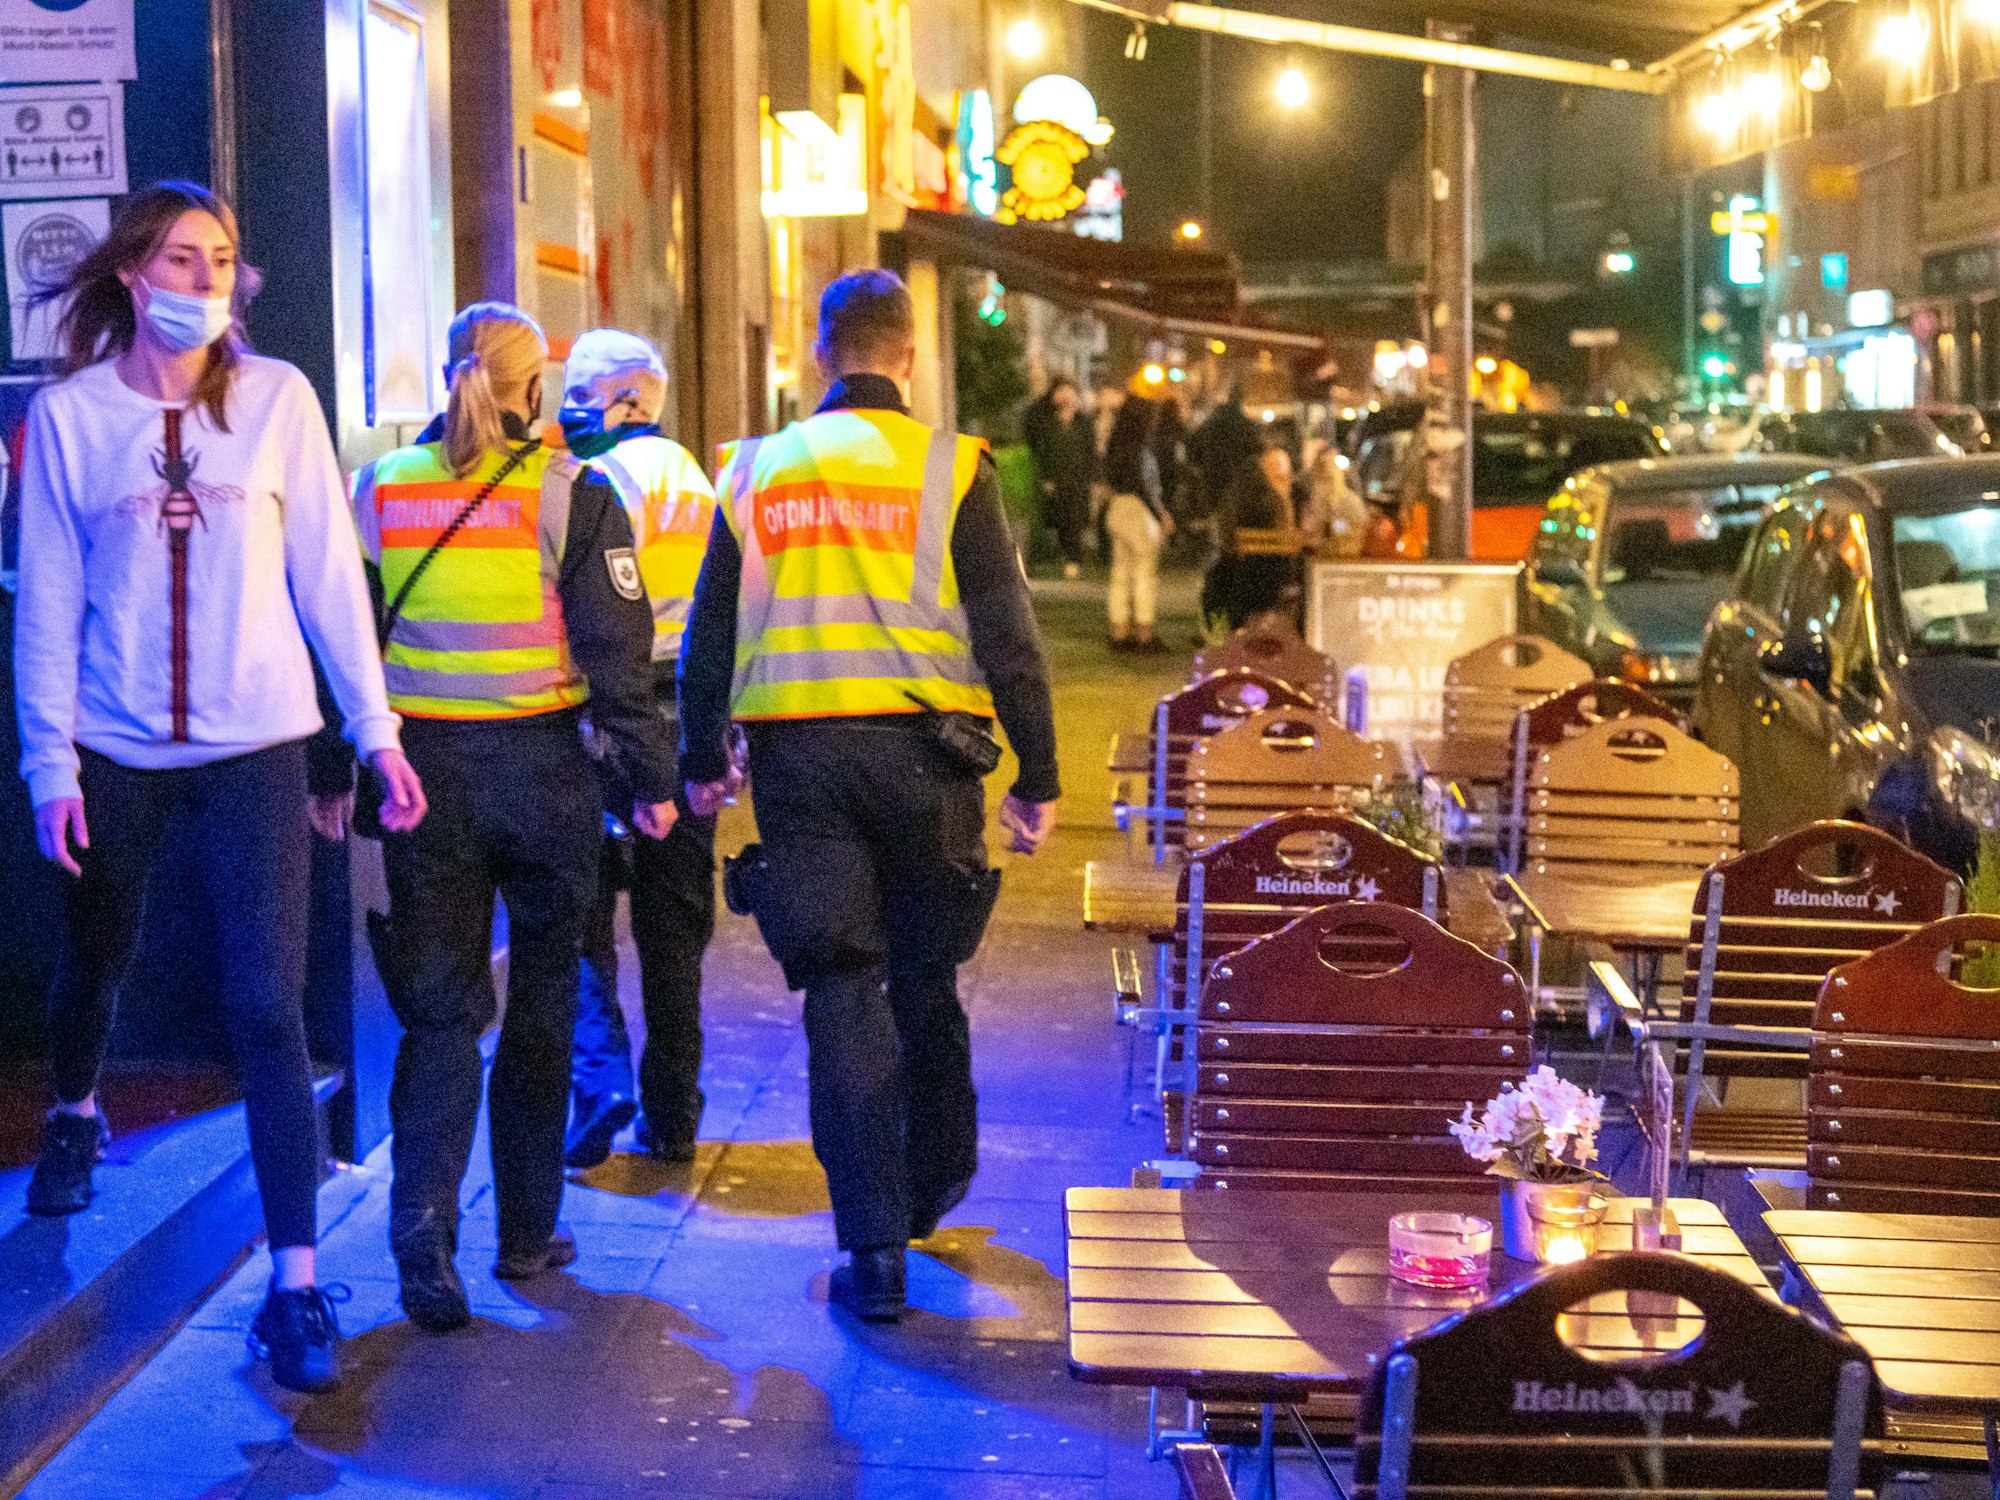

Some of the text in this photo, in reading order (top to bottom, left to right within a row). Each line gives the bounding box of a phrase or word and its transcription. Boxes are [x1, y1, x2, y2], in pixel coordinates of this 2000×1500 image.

[1359, 597, 1465, 623] DRINKS
[1255, 875, 1350, 895] Heineken
[1774, 888, 1869, 907] Heineken
[1513, 1378, 1693, 1413] Heineken
